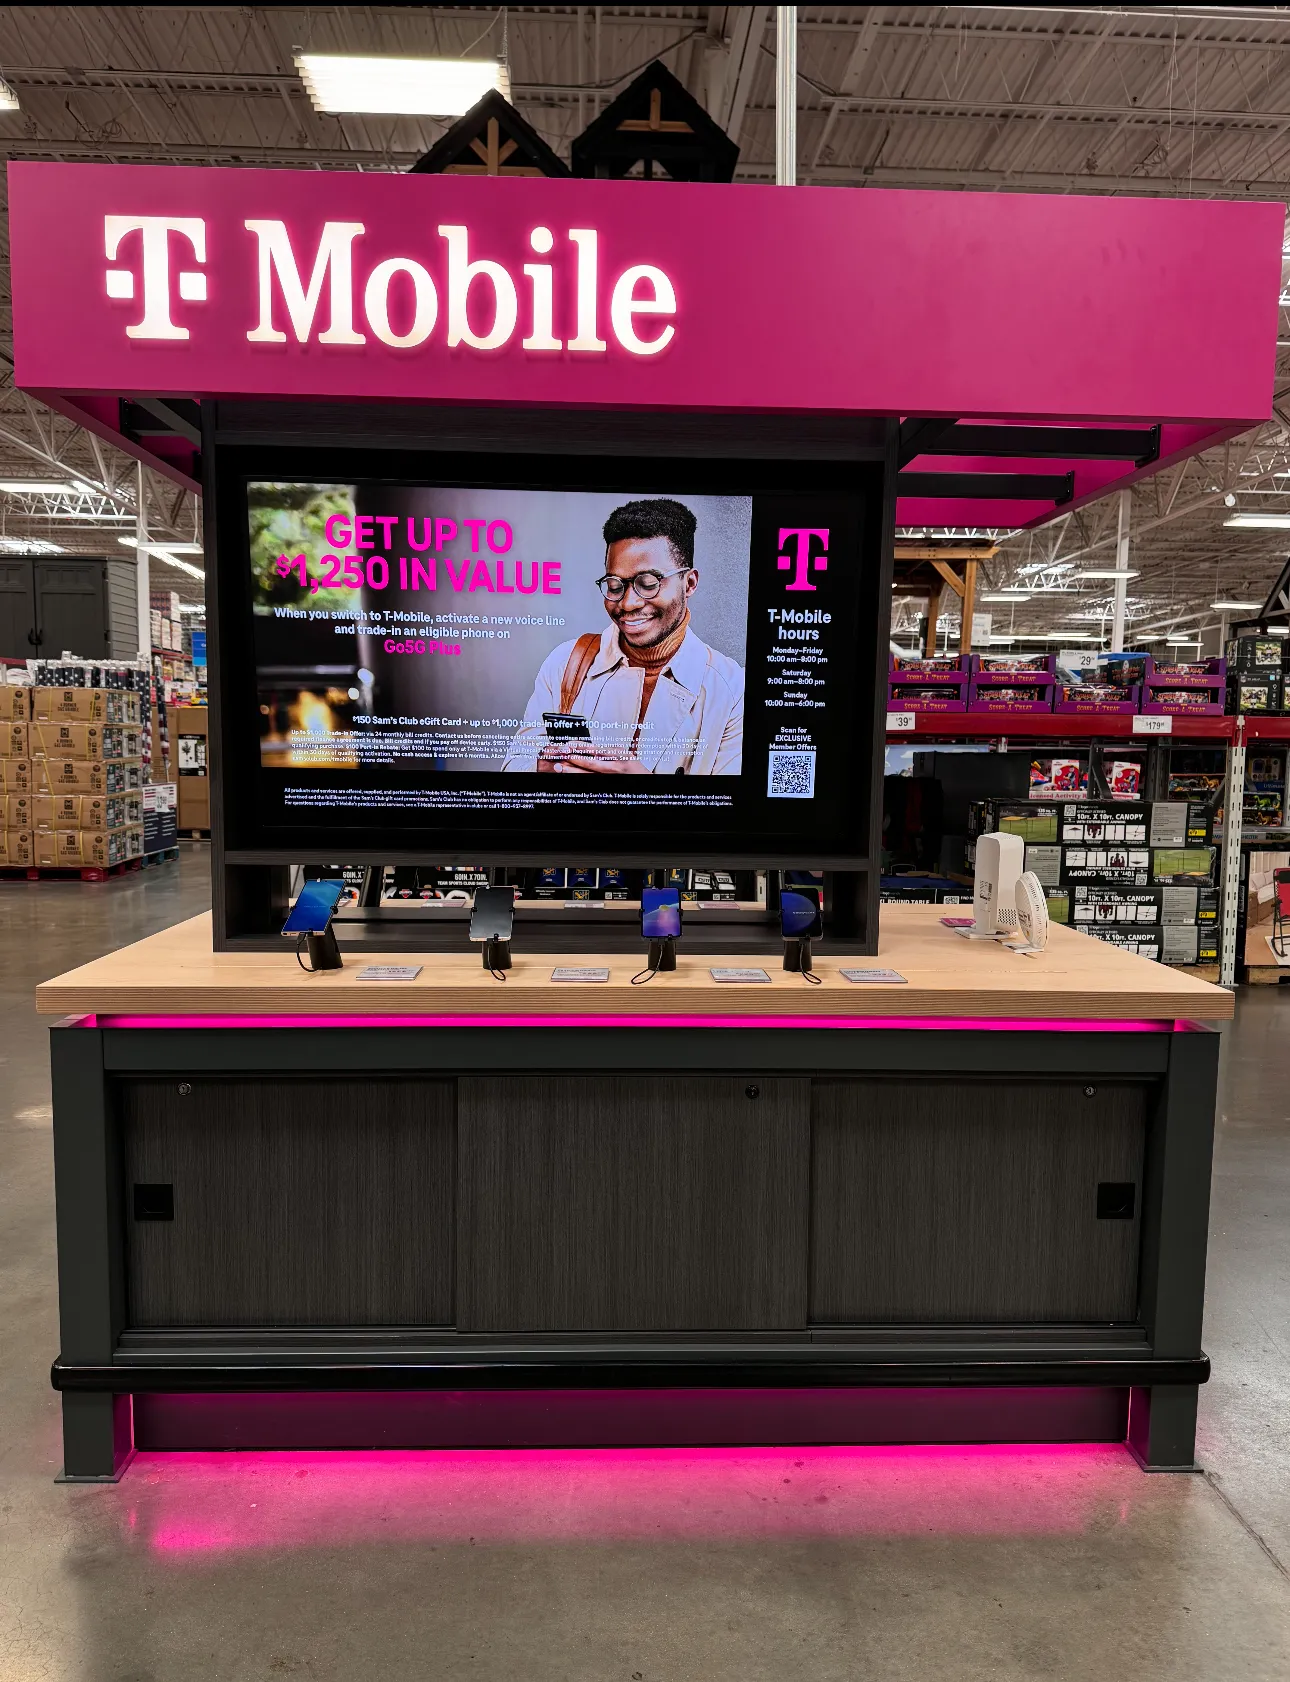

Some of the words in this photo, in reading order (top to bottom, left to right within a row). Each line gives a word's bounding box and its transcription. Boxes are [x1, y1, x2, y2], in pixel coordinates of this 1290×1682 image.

[104, 215, 207, 340] T
[244, 219, 677, 355] Mobile
[325, 514, 398, 550] GET
[407, 517, 458, 552] UP
[463, 519, 513, 554] TO
[777, 528, 829, 591] T
[276, 553, 389, 594] $1,250
[400, 557, 437, 591] IN
[445, 559, 562, 595] VALUE
[274, 607, 307, 619] When
[309, 609, 329, 622] you
[331, 608, 367, 621] switch
[369, 611, 381, 621] to
[383, 611, 434, 624] T-Mobile,
[435, 612, 480, 624] activate
[481, 616, 489, 624] a
[491, 615, 513, 625] new
[515, 614, 544, 625] voice
[545, 614, 566, 626] line
[767, 608, 832, 624] T-Mobile
[334, 624, 355, 635] and
[356, 624, 402, 636] trade-in
[404, 627, 417, 636] an
[419, 625, 459, 639] eligible
[461, 626, 495, 640] phone
[496, 629, 511, 639] on
[778, 625, 820, 641] hours
[384, 639, 426, 655] Go5G
[429, 640, 462, 656] Plus
[766, 655, 785, 663] 10:00
[817, 657, 828, 665] pm
[782, 669, 811, 678] Saturday
[767, 677, 783, 685] 9:00
[814, 679, 825, 687] pm
[765, 699, 784, 707] 10:00
[783, 691, 808, 700] Sunday
[352, 715, 371, 725] $150
[398, 716, 418, 725] Club
[419, 717, 441, 726] eGift
[441, 717, 462, 726] Card
[469, 719, 480, 728] up
[481, 719, 490, 727] to
[492, 719, 518, 728] $1,000
[519, 720, 553, 729] trade-in
[554, 720, 574, 729] offer
[581, 720, 600, 729] $100
[601, 721, 629, 730] port-in
[630, 721, 655, 730] credit
[780, 726, 797, 734] Scan
[797, 726, 807, 734] for
[775, 734, 812, 742] EXCLUSIVE
[796, 743, 817, 751] Offers
